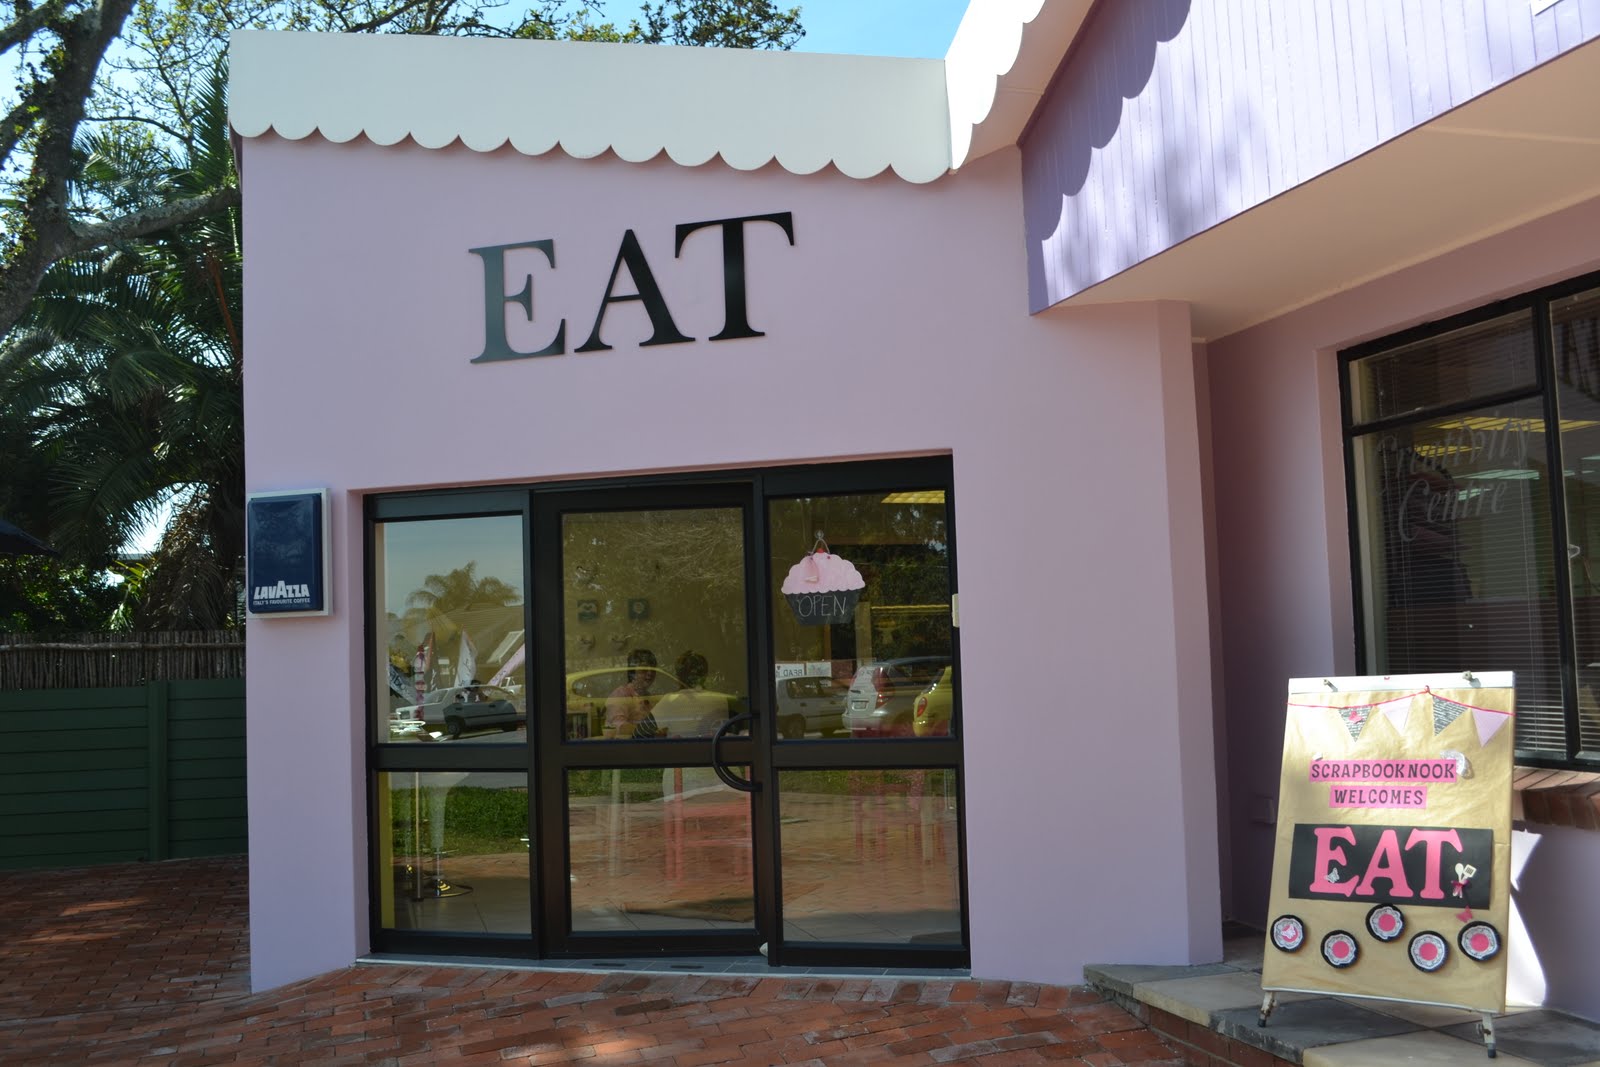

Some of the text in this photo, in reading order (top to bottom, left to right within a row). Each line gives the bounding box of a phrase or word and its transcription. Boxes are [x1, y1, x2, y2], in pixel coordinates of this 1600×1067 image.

[468, 211, 795, 364] EAT
[1400, 479, 1508, 542] Centre
[253, 580, 310, 600] LAVAZZA
[797, 594, 847, 617] OPEN
[1334, 789, 1424, 805] WELCOMES
[1309, 825, 1464, 900] EAT
